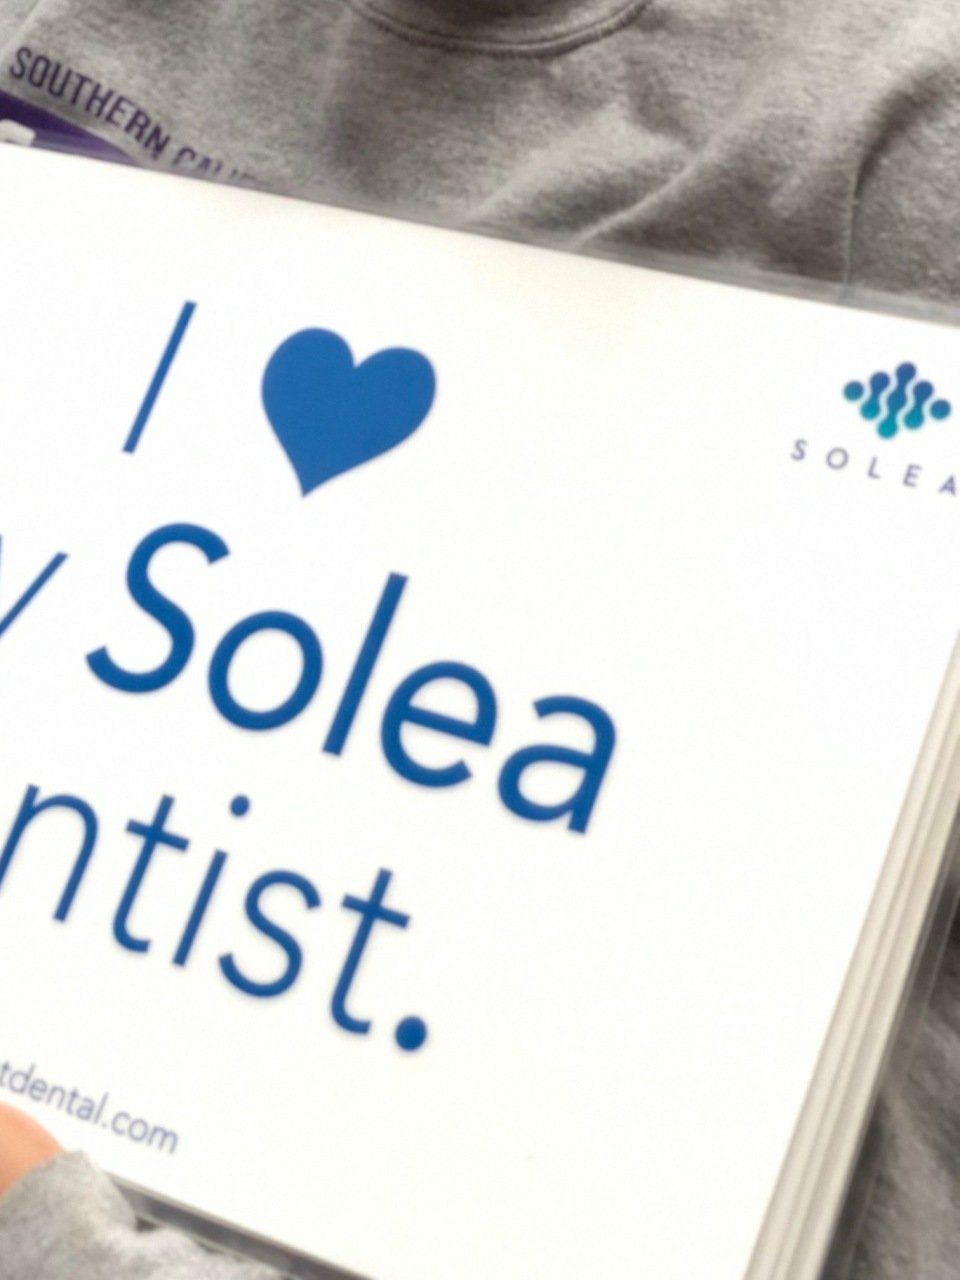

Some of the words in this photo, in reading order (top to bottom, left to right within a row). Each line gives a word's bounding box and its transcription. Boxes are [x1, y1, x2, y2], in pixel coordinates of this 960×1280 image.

[10, 46, 171, 160] SOUTHERN
[122, 300, 197, 454] I
[791, 438, 957, 496] SOLEA
[85, 523, 617, 835] Solea
